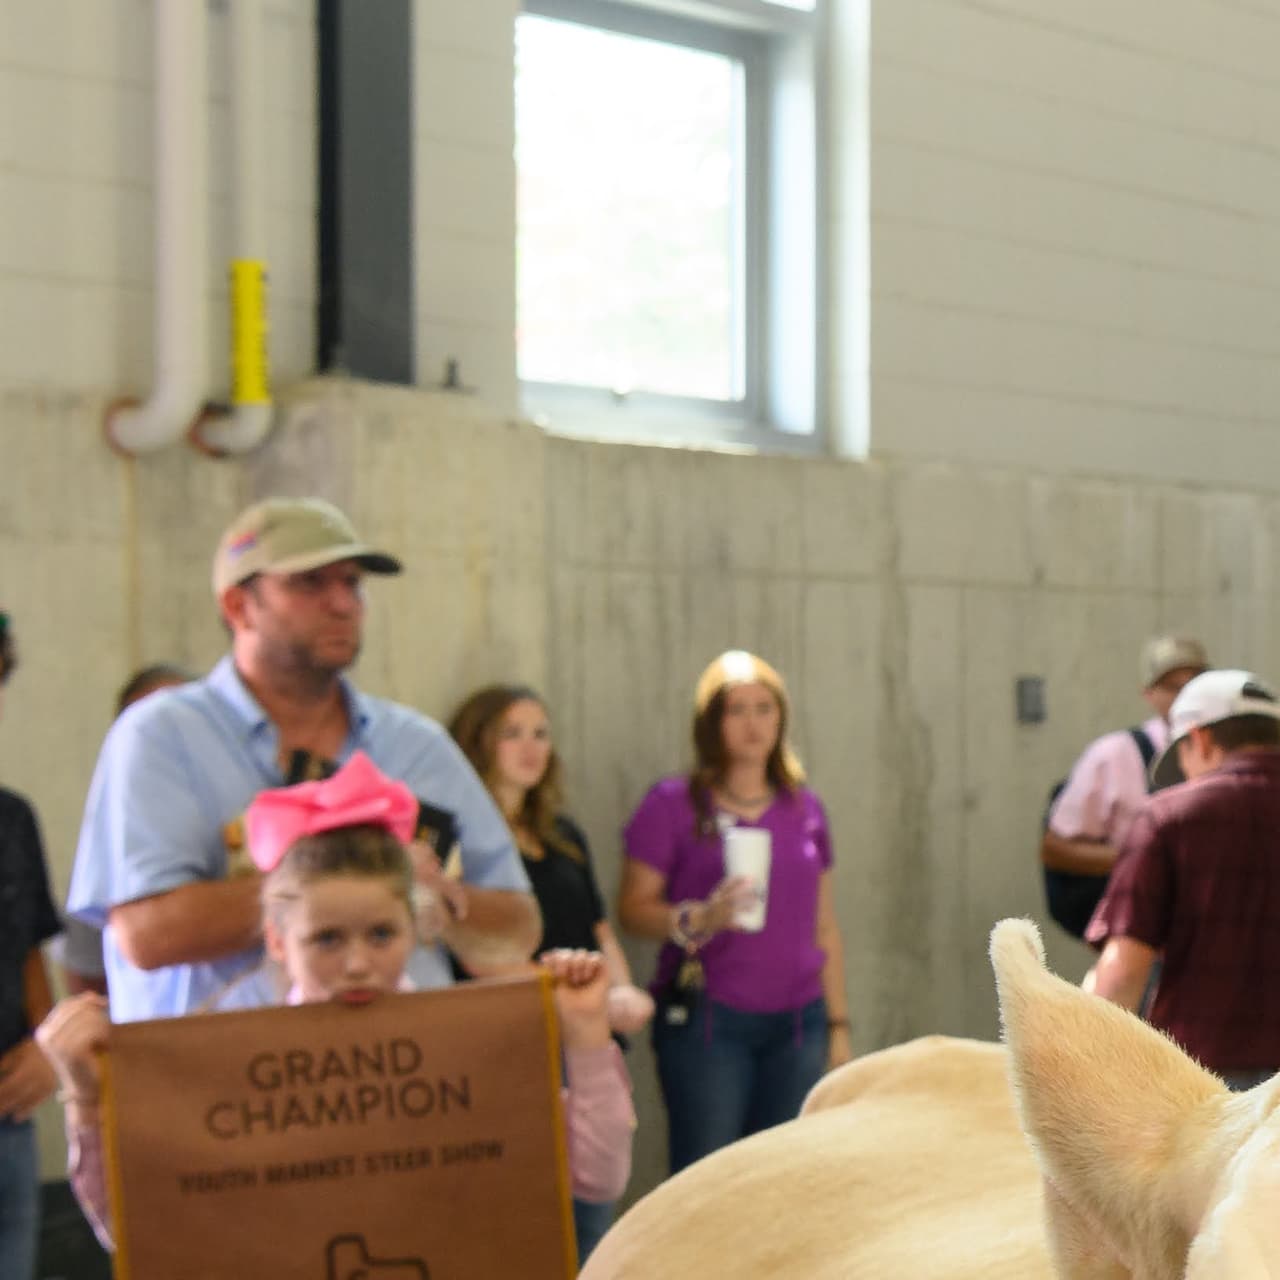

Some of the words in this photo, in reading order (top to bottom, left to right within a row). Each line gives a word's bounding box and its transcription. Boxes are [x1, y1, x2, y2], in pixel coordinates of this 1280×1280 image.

[246, 1037, 423, 1092] GRAND
[204, 1075, 472, 1140] CHAMPION
[178, 1166, 258, 1193] YOUTH
[264, 1155, 355, 1187] MARKET
[362, 1147, 432, 1175] STEER
[439, 1139, 504, 1166] SHOW
